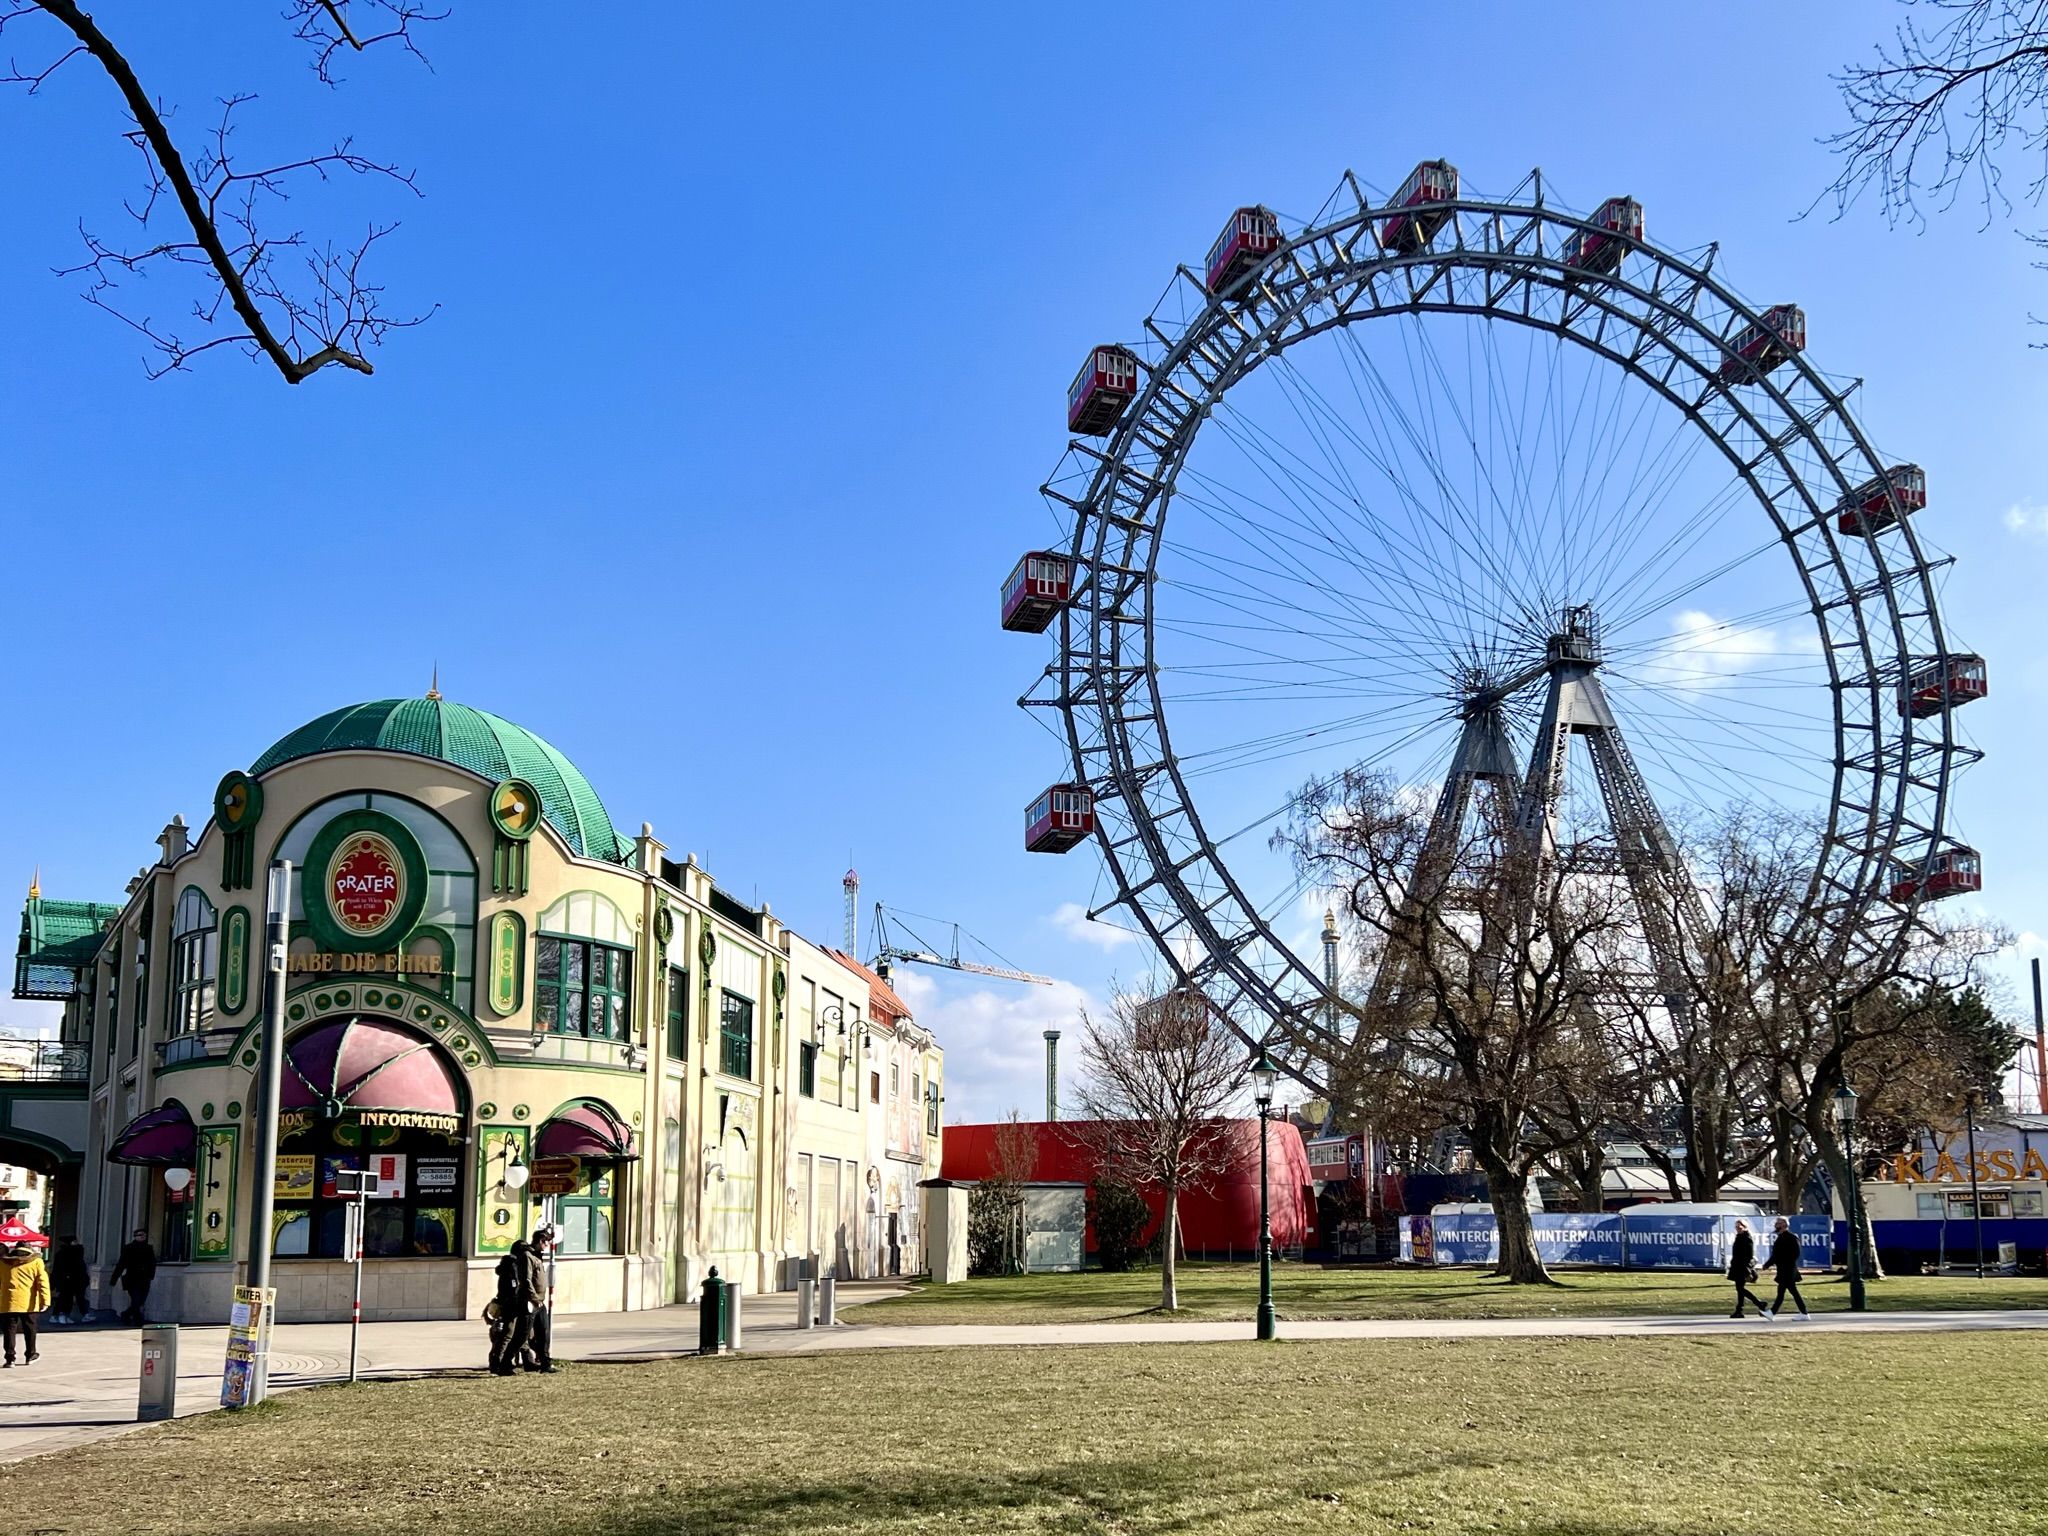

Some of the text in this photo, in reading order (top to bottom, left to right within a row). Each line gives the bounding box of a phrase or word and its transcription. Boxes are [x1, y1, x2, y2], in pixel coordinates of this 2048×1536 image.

[336, 875, 394, 894] PRATER
[340, 953, 377, 972] DIE
[385, 954, 442, 973] EHRE
[360, 1112, 458, 1132] INFORMATION
[1894, 1148, 2048, 1183] KASSA
[1437, 1230, 1499, 1243] WINTERCIR
[1534, 1229, 1620, 1243] WINTERMARKT
[1629, 1232, 1719, 1246] WINTERCIRCUS
[1726, 1233, 1828, 1246] WTERRKT
[236, 1288, 260, 1300] PRATER
[226, 1350, 254, 1362] CIRCUS
